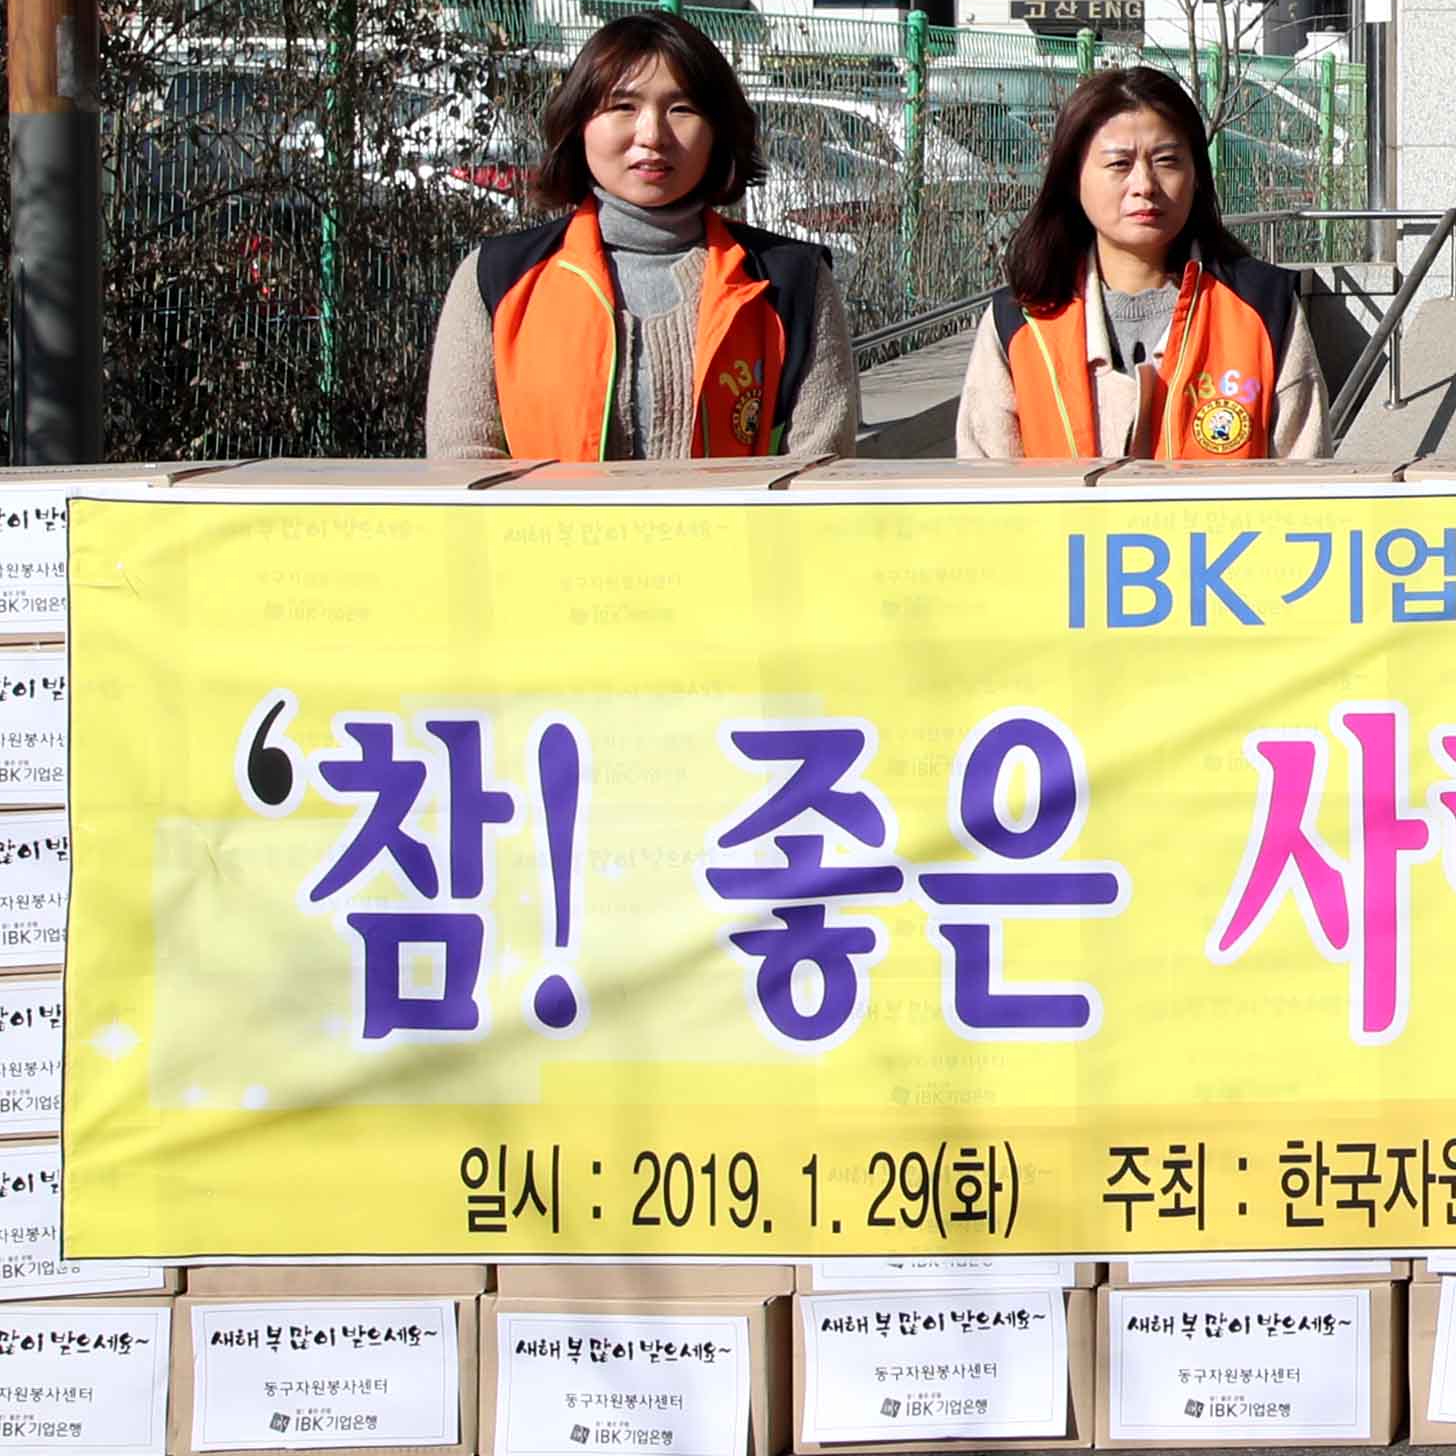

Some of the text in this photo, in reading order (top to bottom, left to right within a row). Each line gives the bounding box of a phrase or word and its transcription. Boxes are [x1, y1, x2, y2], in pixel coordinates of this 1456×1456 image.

[1023, 0, 1142, 19] 고산 ENG
[705, 717, 1121, 1032] 좋은
[460, 1144, 561, 1234] 일시
[631, 1151, 774, 1233] 2019.
[801, 1153, 844, 1234] 1.
[867, 1142, 1019, 1239] 29(화)
[1102, 1143, 1207, 1231] 주최
[821, 1316, 868, 1333] 새해
[876, 1312, 891, 1337] 복
[899, 1311, 944, 1335] 많이
[1128, 1315, 1174, 1335] 새해
[1182, 1312, 1197, 1338] 복
[1205, 1313, 1250, 1338] 많이
[211, 1329, 258, 1348] 새해
[266, 1325, 282, 1352] 복
[290, 1325, 335, 1350] 많이
[516, 1339, 560, 1359] 새해
[568, 1336, 582, 1363] 복
[590, 1338, 633, 1363] 많이
[874, 1362, 997, 1382] 동구자원봉사센터
[1177, 1367, 1301, 1385] 동구자원봉사센터
[263, 1378, 388, 1398] 동구자원봉사센터
[566, 1393, 683, 1411] 동구자원봉사센터
